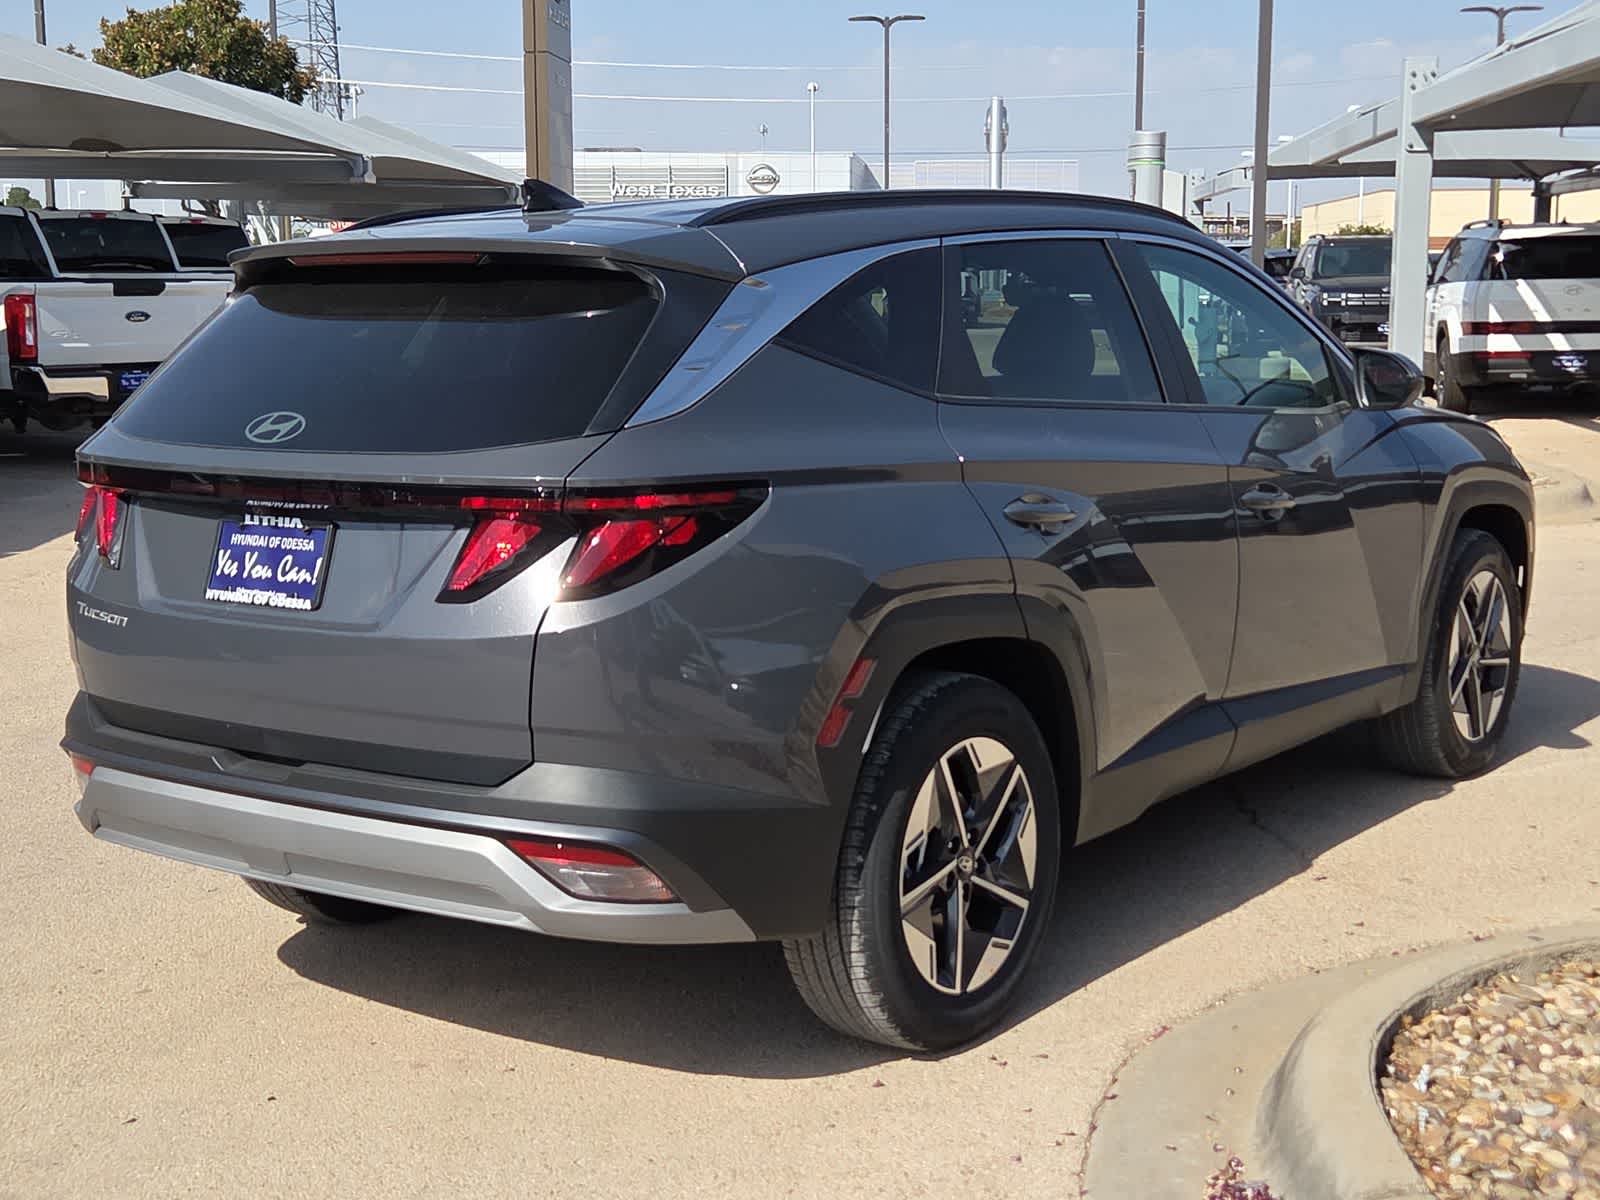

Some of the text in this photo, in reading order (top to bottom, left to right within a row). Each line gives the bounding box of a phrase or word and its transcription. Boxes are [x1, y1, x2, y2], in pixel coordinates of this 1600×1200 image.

[609, 182, 720, 197] West Texas
[244, 513, 304, 529] LITHIA
[230, 533, 315, 552] HYUNDAI OF ODESSA
[216, 549, 323, 585] Yes You Can!
